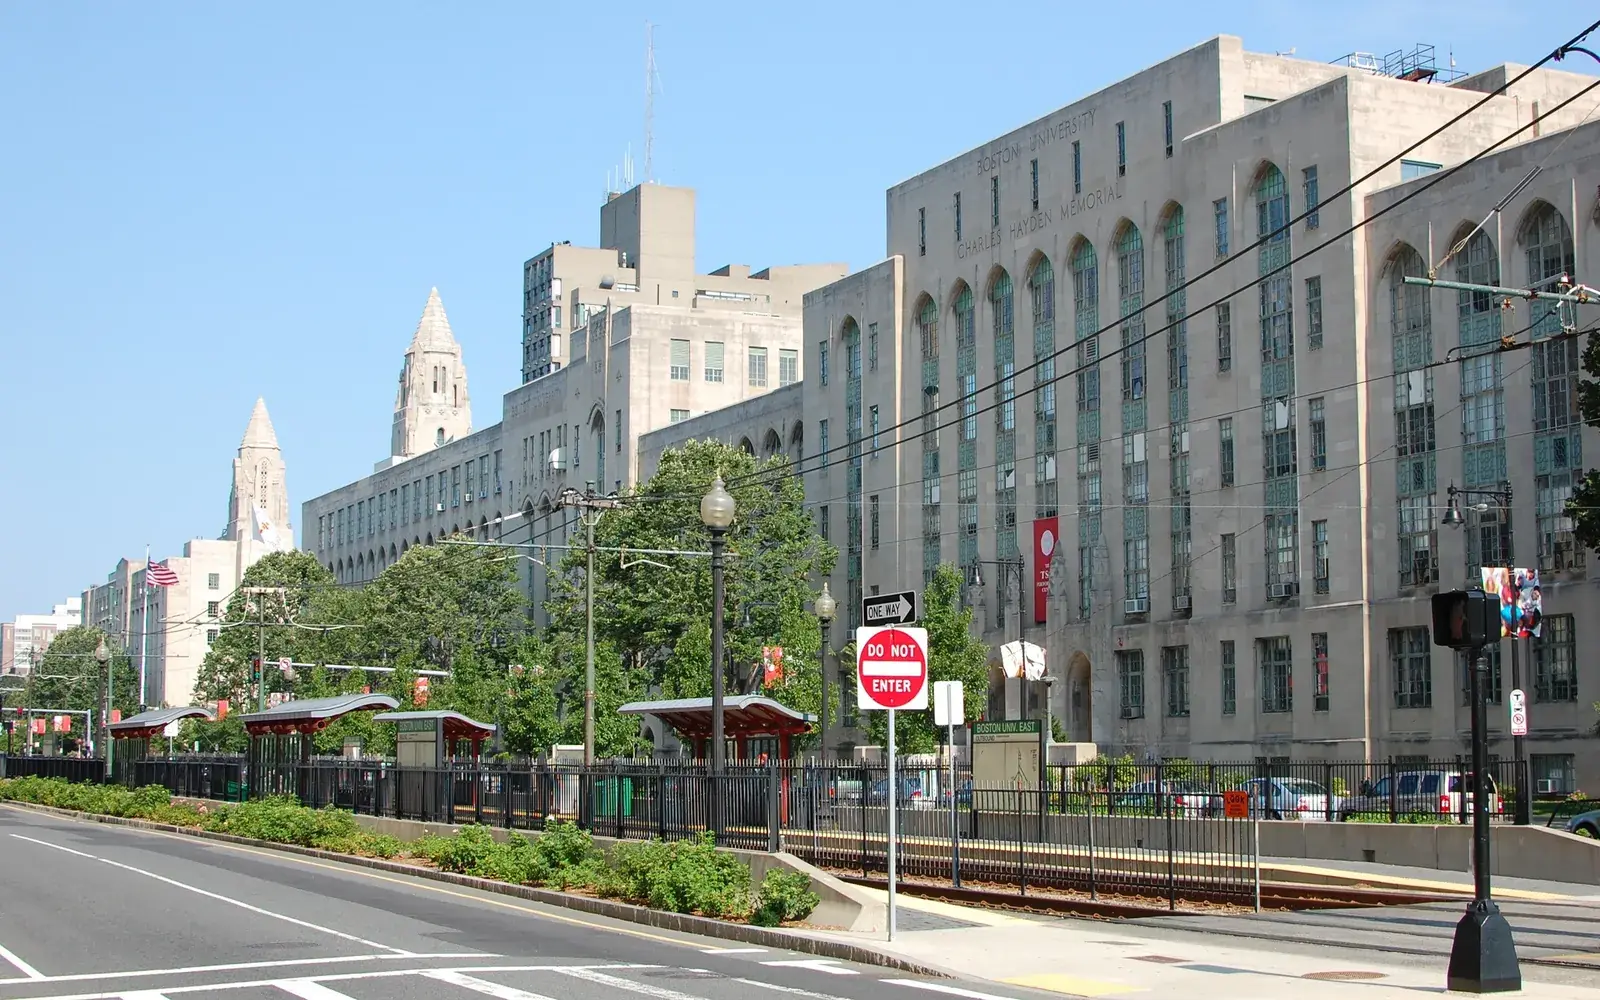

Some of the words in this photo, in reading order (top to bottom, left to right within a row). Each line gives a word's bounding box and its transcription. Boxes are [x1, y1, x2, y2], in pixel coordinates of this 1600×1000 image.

[977, 143, 1020, 176] BOSTON
[1029, 108, 1097, 152] UNIVERSITY
[957, 229, 1001, 260] CHARLES
[1009, 209, 1052, 240] HAYDEN
[1060, 183, 1122, 221] MEMORIAL
[868, 605, 883, 619] ONE
[885, 602, 901, 616] WAY
[867, 644, 884, 657] DO
[891, 644, 916, 657] NOT
[872, 679, 911, 693] ENTER
[976, 722, 1001, 733] BOSTON
[1002, 722, 1018, 732] UNIV.
[1019, 721, 1035, 732] EAST
[1227, 795, 1245, 804] LOOK
